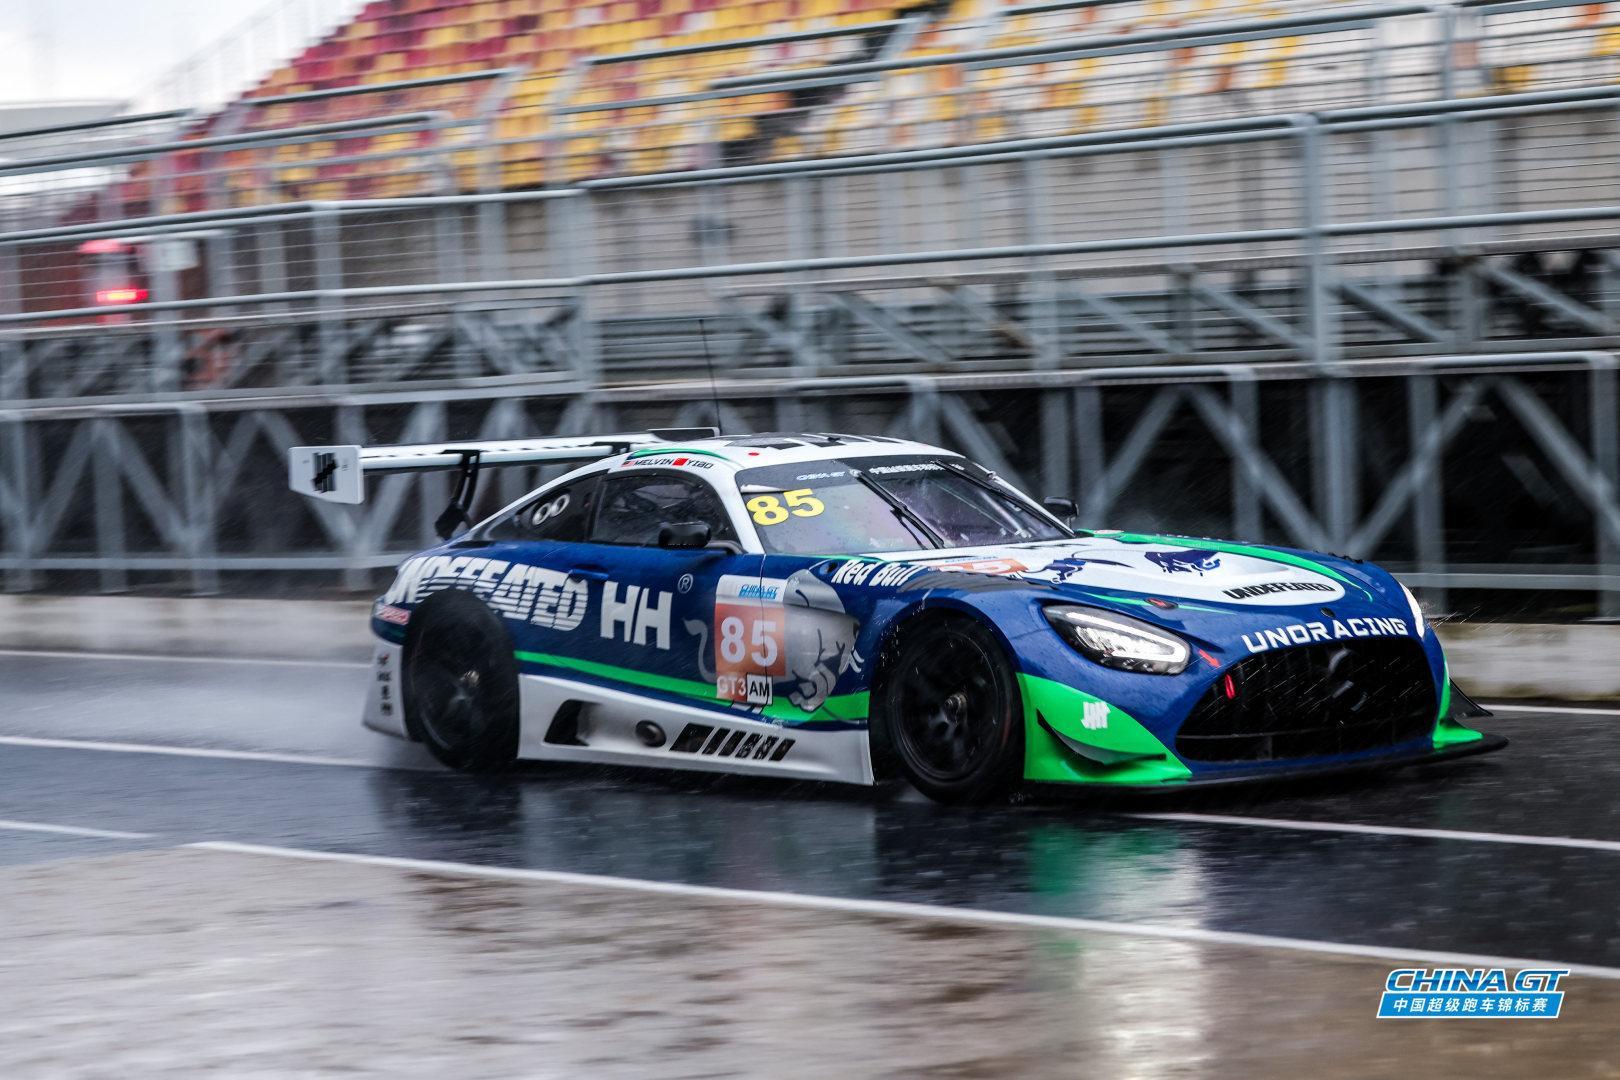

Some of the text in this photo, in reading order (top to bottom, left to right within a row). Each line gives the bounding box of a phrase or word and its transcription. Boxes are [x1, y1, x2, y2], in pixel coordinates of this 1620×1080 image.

[634, 458, 674, 466] MELVIN
[746, 488, 825, 526] 85
[831, 559, 927, 587] Red Bull
[1222, 582, 1337, 600] UNDEFEATED
[600, 580, 673, 650] HH
[720, 616, 778, 667] 85
[1241, 617, 1409, 654] UNORACING
[717, 675, 770, 698] GT3 AM
